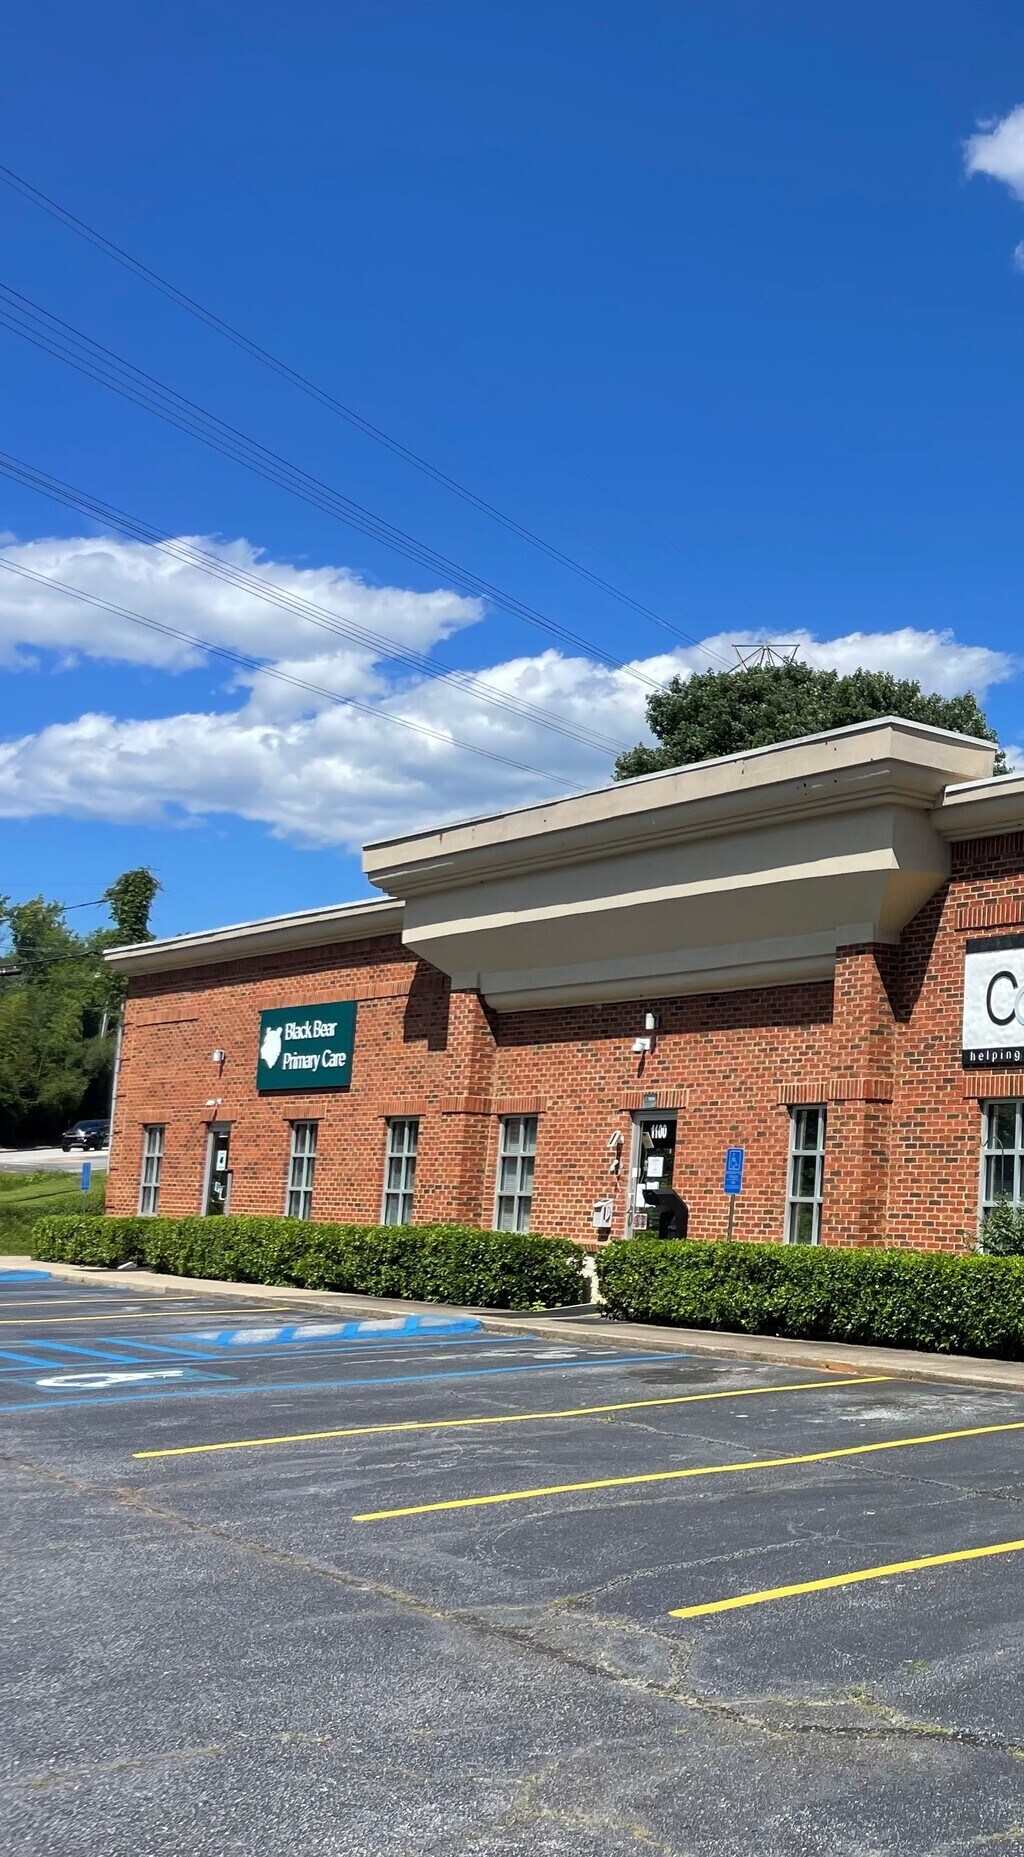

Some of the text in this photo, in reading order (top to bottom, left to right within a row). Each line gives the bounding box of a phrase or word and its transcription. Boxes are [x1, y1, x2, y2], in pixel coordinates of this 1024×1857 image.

[285, 1020, 338, 1040] Black Bear
[282, 1049, 347, 1072] Primary Care
[970, 1050, 1021, 1063] helping
[651, 1124, 667, 1139] 1100
